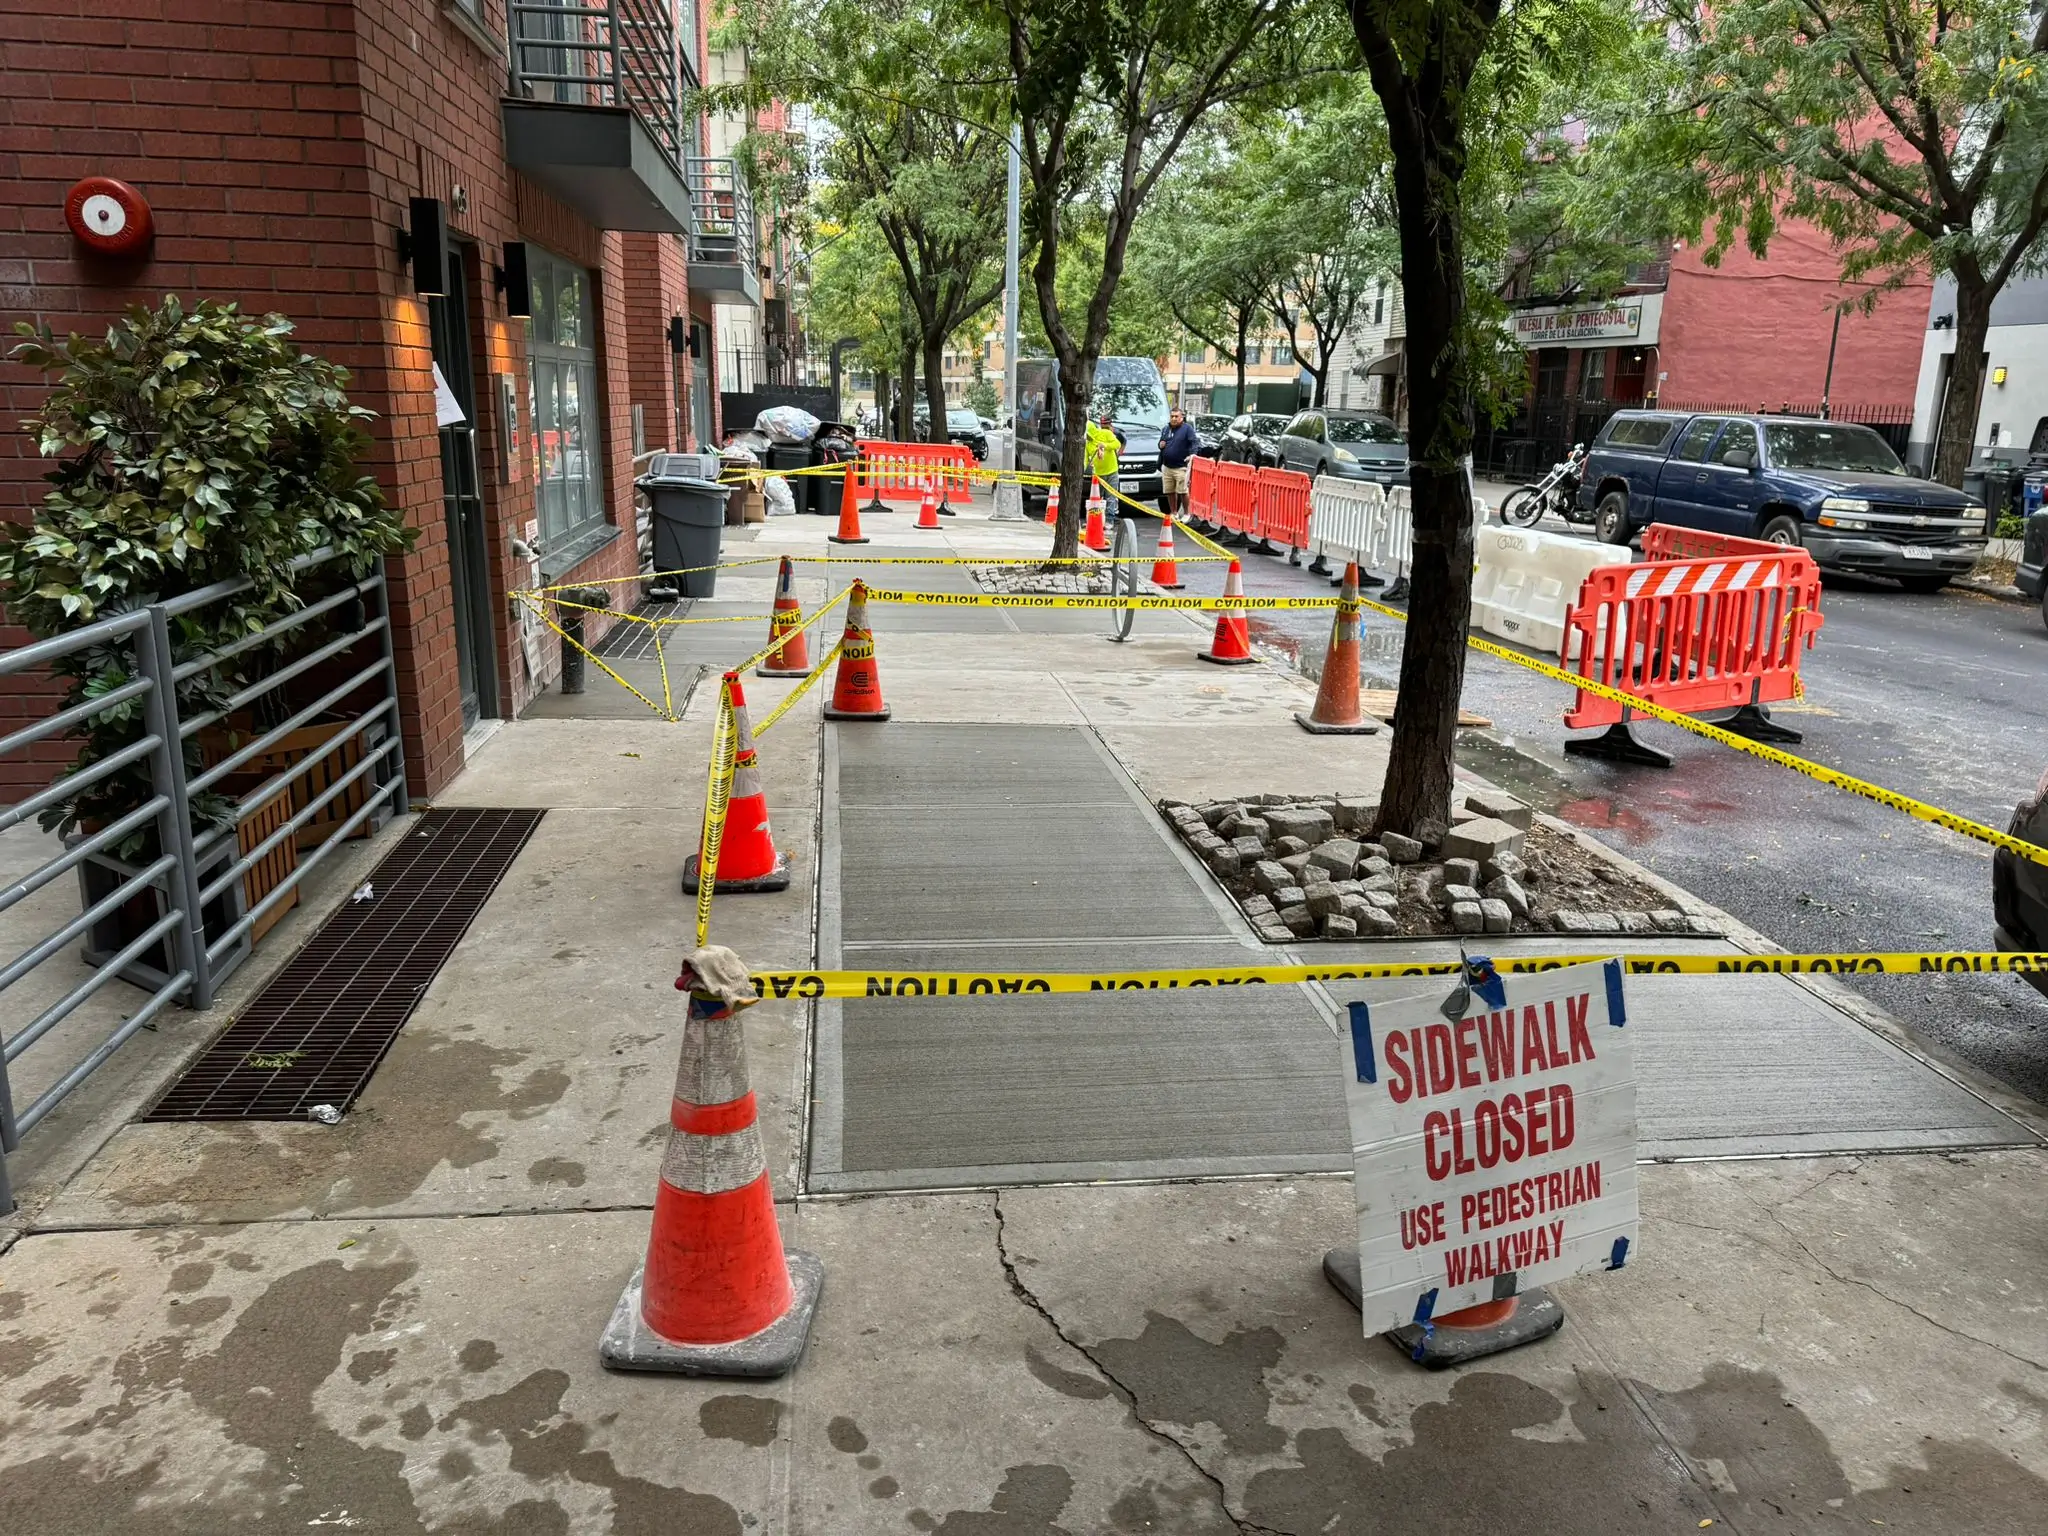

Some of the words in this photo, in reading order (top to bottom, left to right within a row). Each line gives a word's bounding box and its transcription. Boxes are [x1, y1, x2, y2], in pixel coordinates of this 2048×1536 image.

[1518, 317, 1542, 332] IGLESIA
[1545, 315, 1554, 330] DE
[1555, 314, 1573, 329] DIOS
[1575, 309, 1626, 328] PENTECOSTAL
[1531, 330, 1548, 340] TORRE
[1549, 329, 1557, 339] DE
[1557, 329, 1566, 338] LA
[1384, 992, 1596, 1104] SIDEWALK
[1424, 1083, 1575, 1182] CLOSED
[1400, 1201, 1446, 1250] USE
[1460, 1160, 1601, 1234] PEDESTRIAN
[1444, 1220, 1564, 1288] WALKWAY
